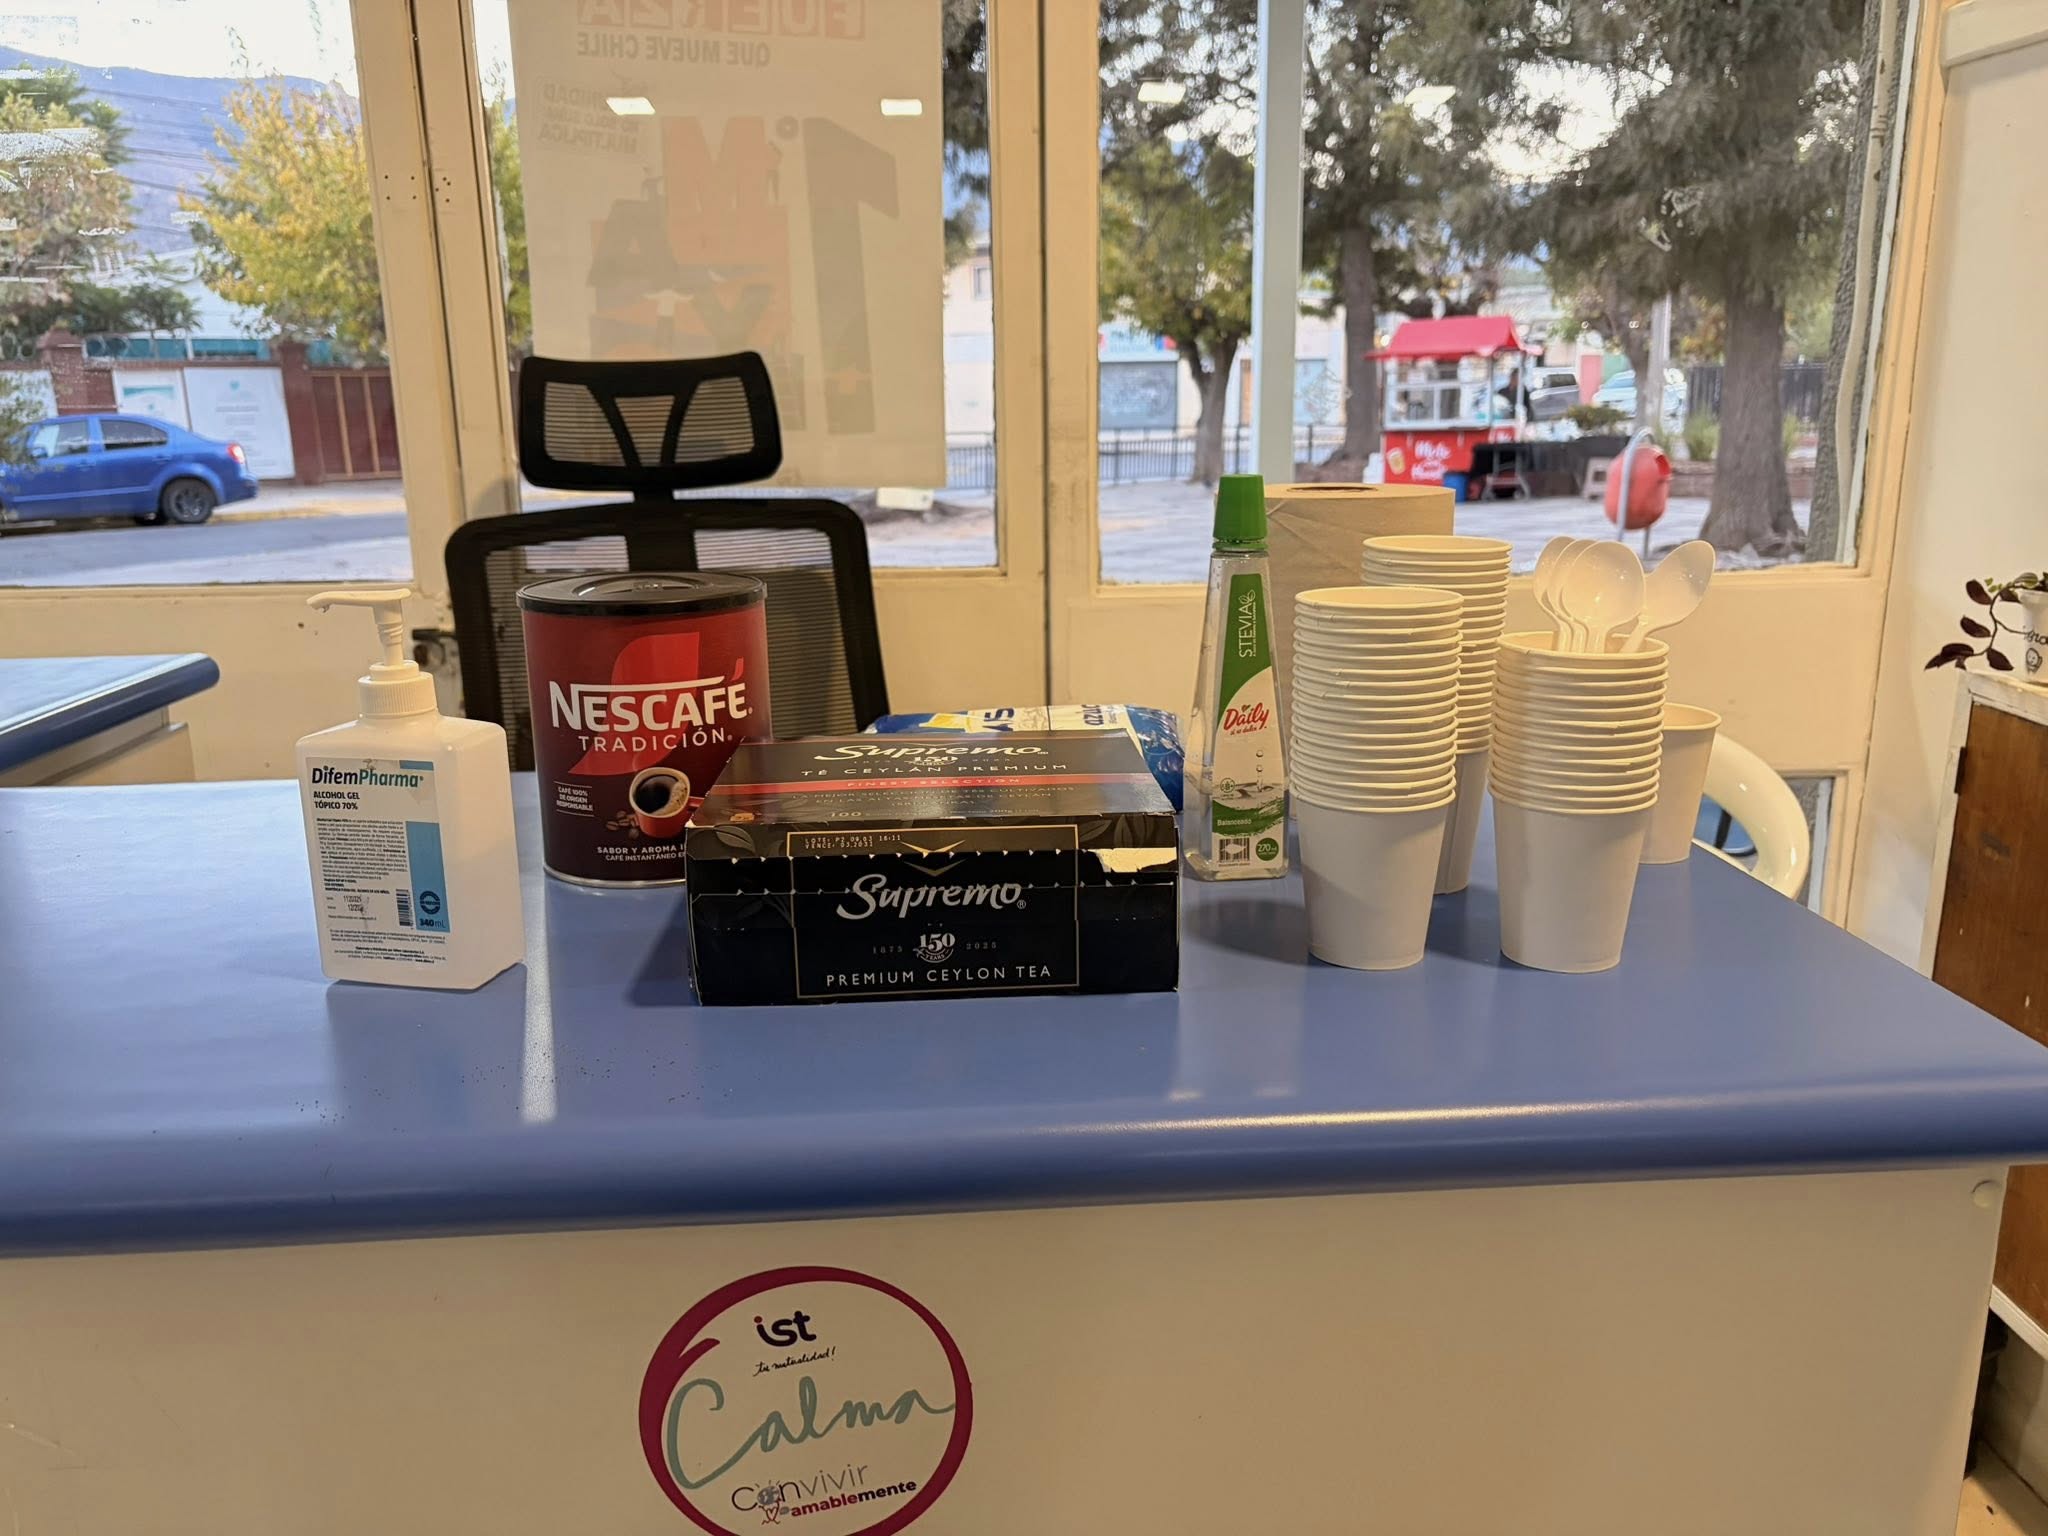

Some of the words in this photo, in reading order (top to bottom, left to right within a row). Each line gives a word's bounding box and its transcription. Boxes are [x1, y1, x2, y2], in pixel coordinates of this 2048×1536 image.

[1237, 602, 1253, 658] STEVIA
[549, 657, 749, 733] NESCAFÉ
[1223, 702, 1270, 731] Daily
[577, 727, 725, 753] TRADICIÓN
[813, 744, 1042, 761] Supremo
[958, 764, 1067, 772] PREMIUM
[313, 790, 346, 800] ALCOHOL
[346, 791, 361, 800] GEL
[314, 799, 341, 810] TÓPICO
[342, 801, 359, 810] 70%
[597, 846, 628, 854] SABOR
[641, 844, 677, 854] AROMA
[605, 853, 625, 862] CAFÉ
[1258, 843, 1271, 852] 270
[419, 917, 435, 927] 340
[919, 932, 956, 952] 150
[826, 969, 915, 987] PREMIUM
[926, 966, 1008, 983] CEYLON
[1015, 964, 1053, 979] TEA
[753, 1310, 817, 1347] ist
[666, 1376, 957, 1490] Calma
[790, 1480, 918, 1518] amablemente
